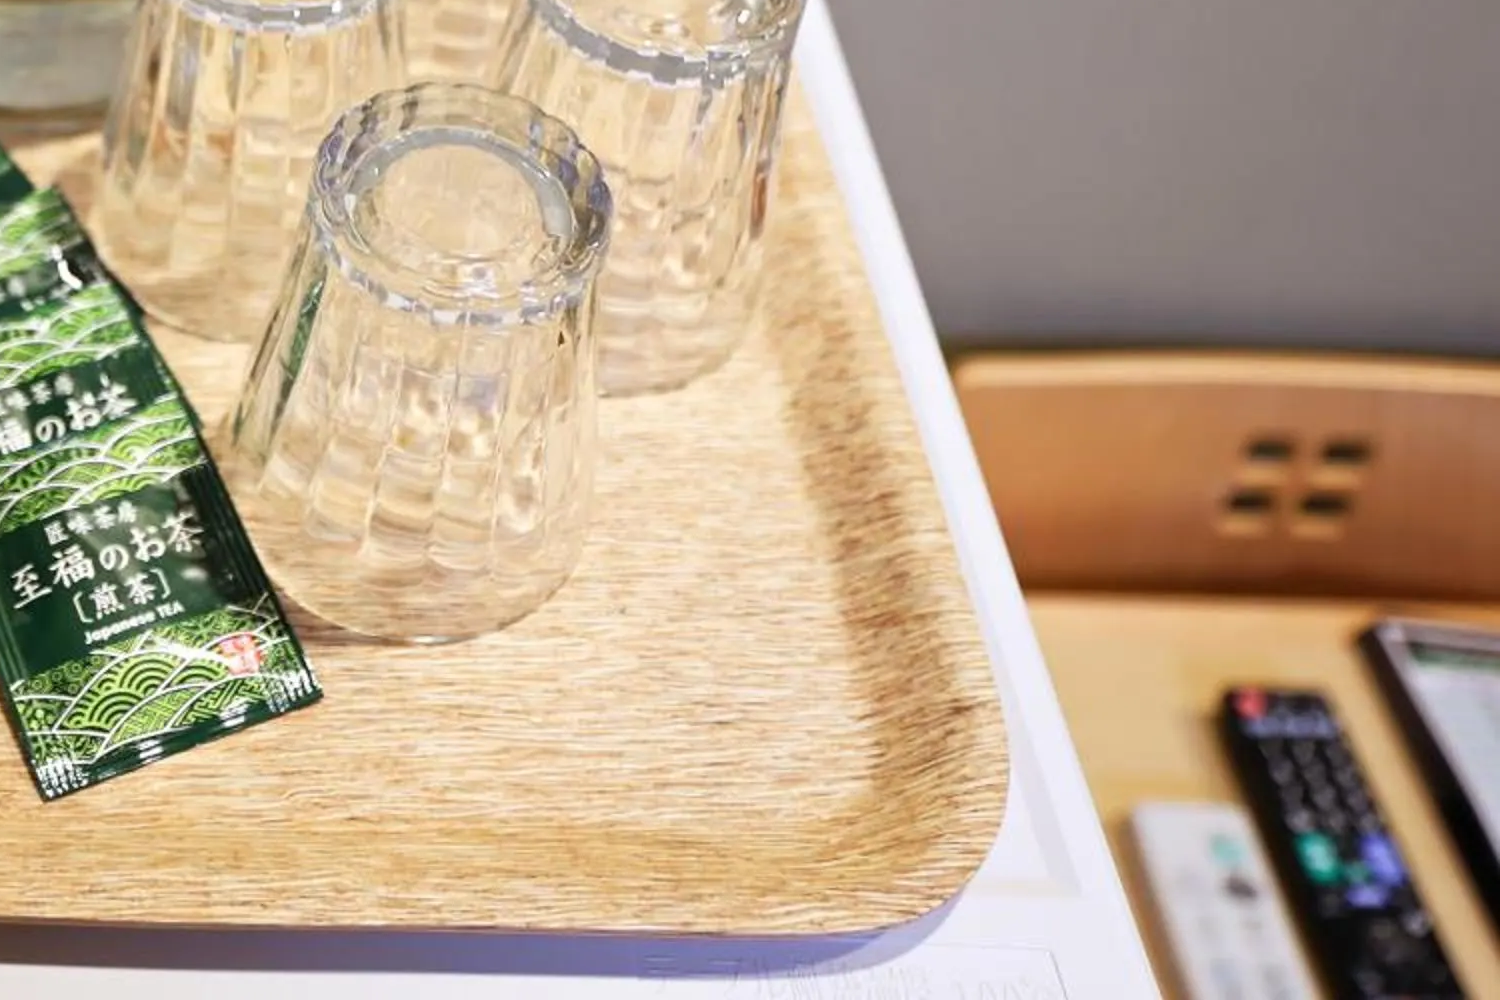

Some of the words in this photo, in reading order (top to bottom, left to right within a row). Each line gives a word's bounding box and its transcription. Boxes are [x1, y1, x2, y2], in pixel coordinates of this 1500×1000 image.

[11, 511, 204, 609] 至福のお茶
[84, 611, 156, 645] Japanese
[156, 600, 186, 619] TEA
